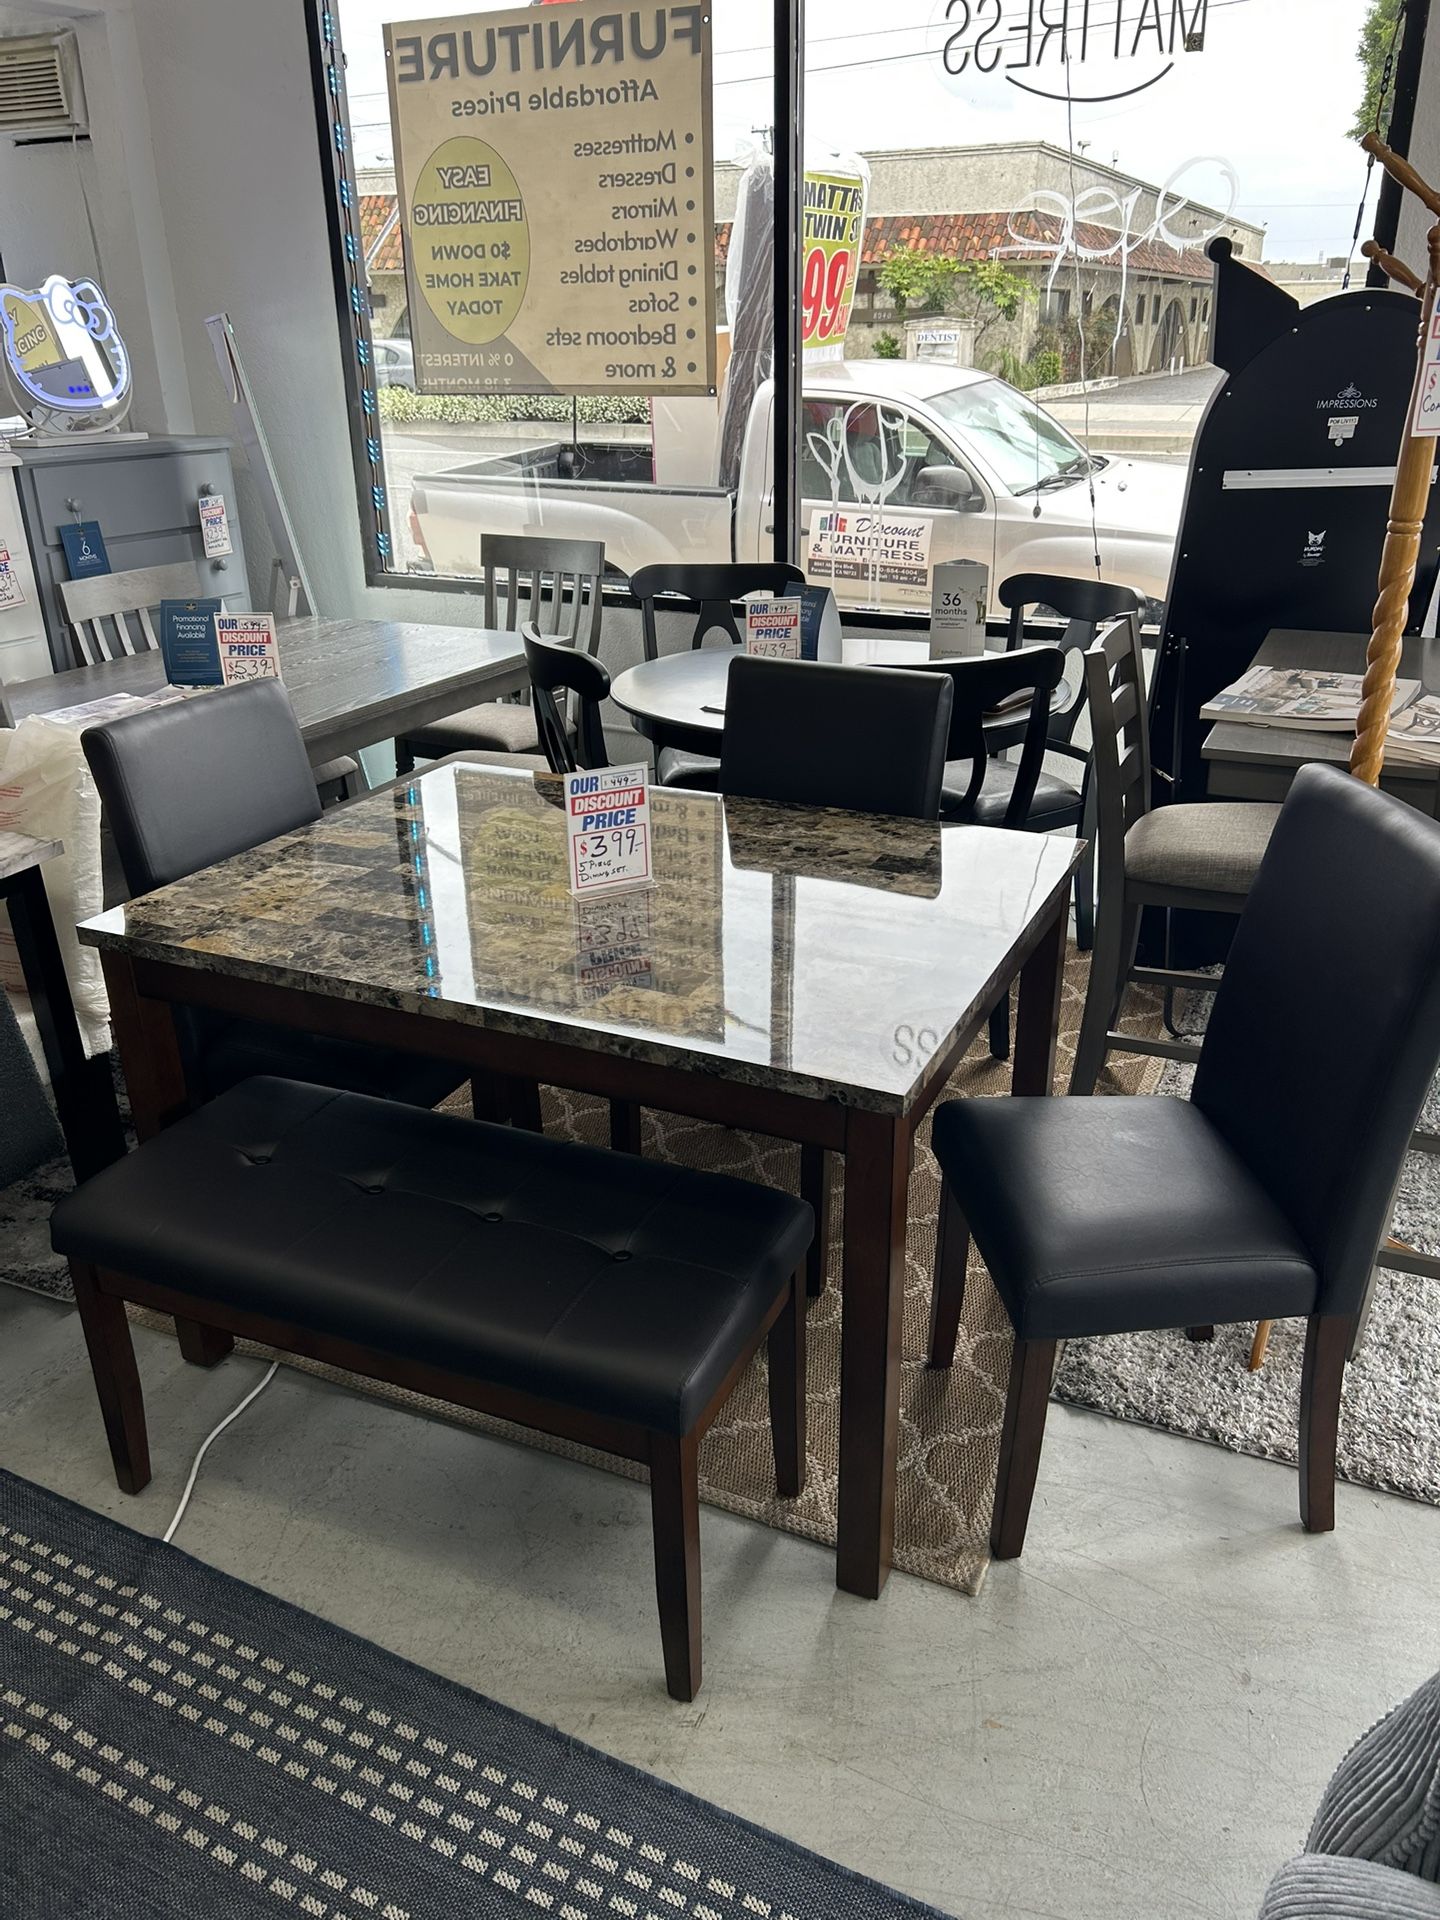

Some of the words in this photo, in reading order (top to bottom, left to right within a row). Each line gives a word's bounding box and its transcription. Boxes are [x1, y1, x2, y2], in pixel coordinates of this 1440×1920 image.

[804, 212, 848, 242] TWIN
[917, 333, 959, 341] DENTIST
[1316, 398, 1379, 409] IMPRESSIONS
[82, 540, 91, 555] 6
[819, 533, 920, 551] FURNITURE
[812, 543, 823, 553] &
[830, 545, 925, 562] MATTRESS
[942, 593, 961, 606] 36
[749, 604, 768, 615] OUR
[176, 623, 206, 631] Financing
[218, 618, 238, 630] OUR
[751, 615, 796, 627] DISCOUNT
[222, 631, 269, 643] DISCOUNT
[756, 628, 792, 639] PRICE
[228, 645, 266, 656] PRICE
[570, 776, 599, 795] OUR
[574, 789, 642, 814] DISCOUNT
[582, 808, 636, 831] PRICE
[578, 861, 587, 872] 5
